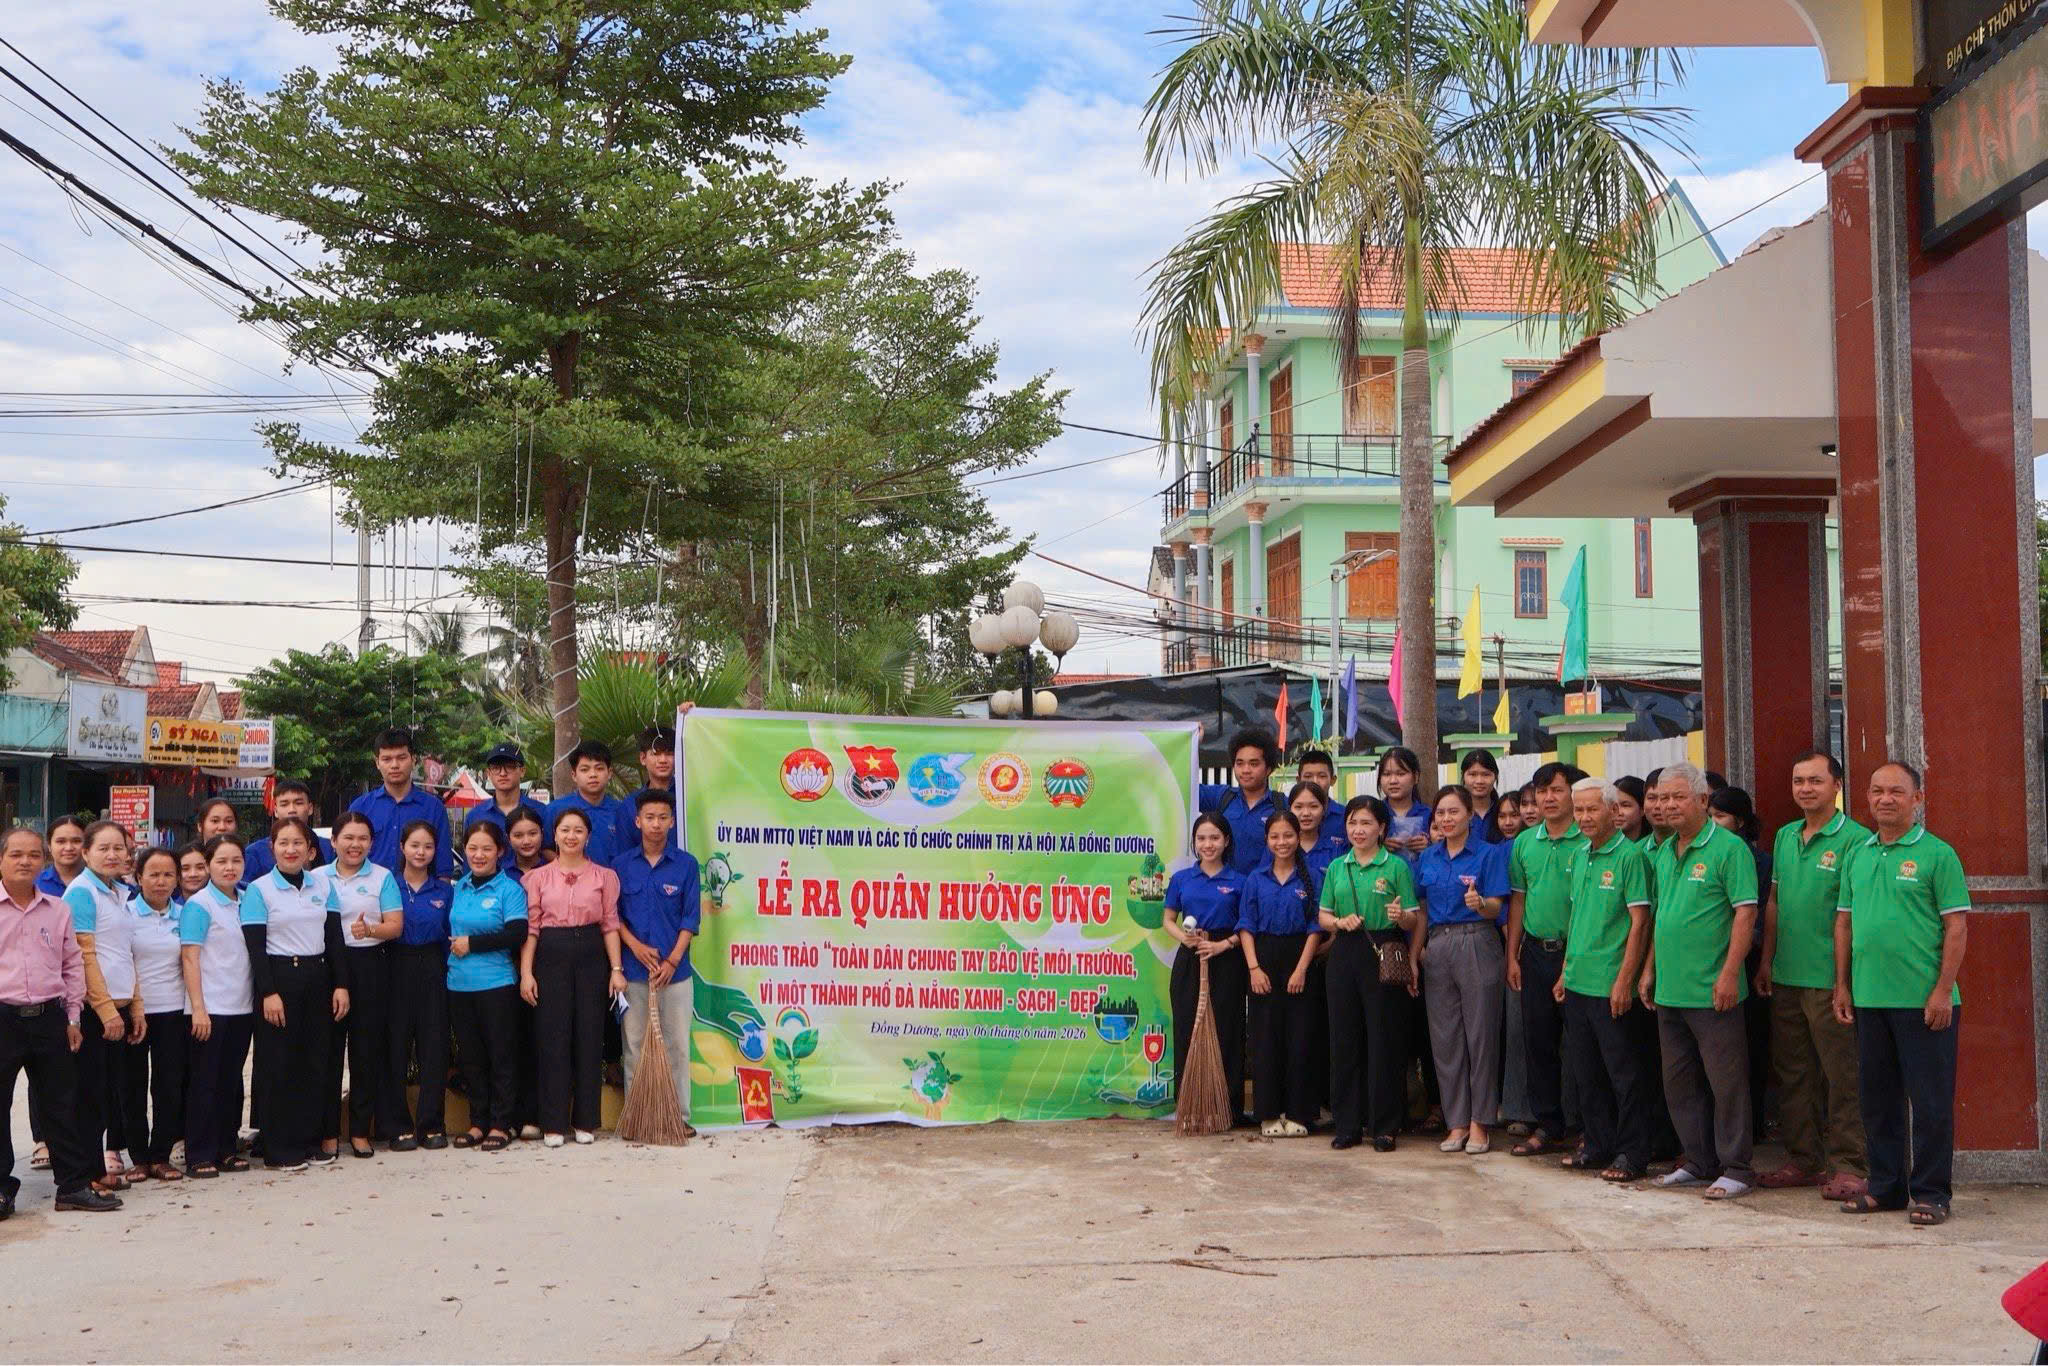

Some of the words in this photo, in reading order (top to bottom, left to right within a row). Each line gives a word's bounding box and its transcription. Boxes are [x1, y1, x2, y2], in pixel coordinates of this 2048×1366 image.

[190, 728, 219, 743] NGA
[718, 820, 732, 843] ỦY
[735, 826, 759, 844] BAN
[763, 828, 794, 846] MTTQ
[798, 826, 823, 849] VIỆT
[826, 829, 854, 846] NAM
[858, 827, 872, 847] VÀ
[876, 827, 900, 848] CÁC
[904, 825, 918, 848] TỔ
[921, 829, 952, 849] CHỨC
[956, 829, 992, 850] CHÍNH
[996, 834, 1013, 854] TRỊ
[1017, 832, 1032, 851] XÃ
[1037, 831, 1056, 855] HỘI
[1060, 833, 1075, 852] XÃ
[1079, 830, 1111, 853] ĐỒNG
[1115, 836, 1154, 854] DƯƠNG
[757, 860, 793, 916] LỄ
[801, 879, 842, 917] RA
[850, 872, 931, 929] QUÂN
[938, 872, 1042, 923] HƯỞNG
[1051, 876, 1111, 924] ỨNG
[730, 944, 778, 967] PHONG
[782, 941, 819, 968] TRÀO
[873, 944, 903, 970] DÂN
[907, 948, 957, 972] CHUNG
[961, 950, 984, 972] TAY
[988, 944, 1018, 973] BẢO
[1022, 947, 1039, 979] VỆ
[1043, 948, 1071, 975] MÔI
[1076, 948, 1138, 979] TRƯỜNG,
[760, 978, 772, 1005] VÌ
[777, 979, 806, 1010] MỘT
[810, 979, 857, 1007] THÀNH
[862, 978, 892, 1008] PHỐ
[895, 982, 915, 1009] ĐÀ
[964, 987, 1003, 1011] XANH
[1017, 989, 1056, 1017] SẠCH
[870, 1021, 900, 1036] Đồng
[903, 1022, 942, 1038] Dương,
[945, 1027, 970, 1039] ngày
[973, 1026, 987, 1037] 06
[990, 1025, 1021, 1040] tháng
[1023, 1026, 1031, 1039] 6
[1033, 1027, 1057, 1039] năm
[1060, 1027, 1086, 1040] 2026
